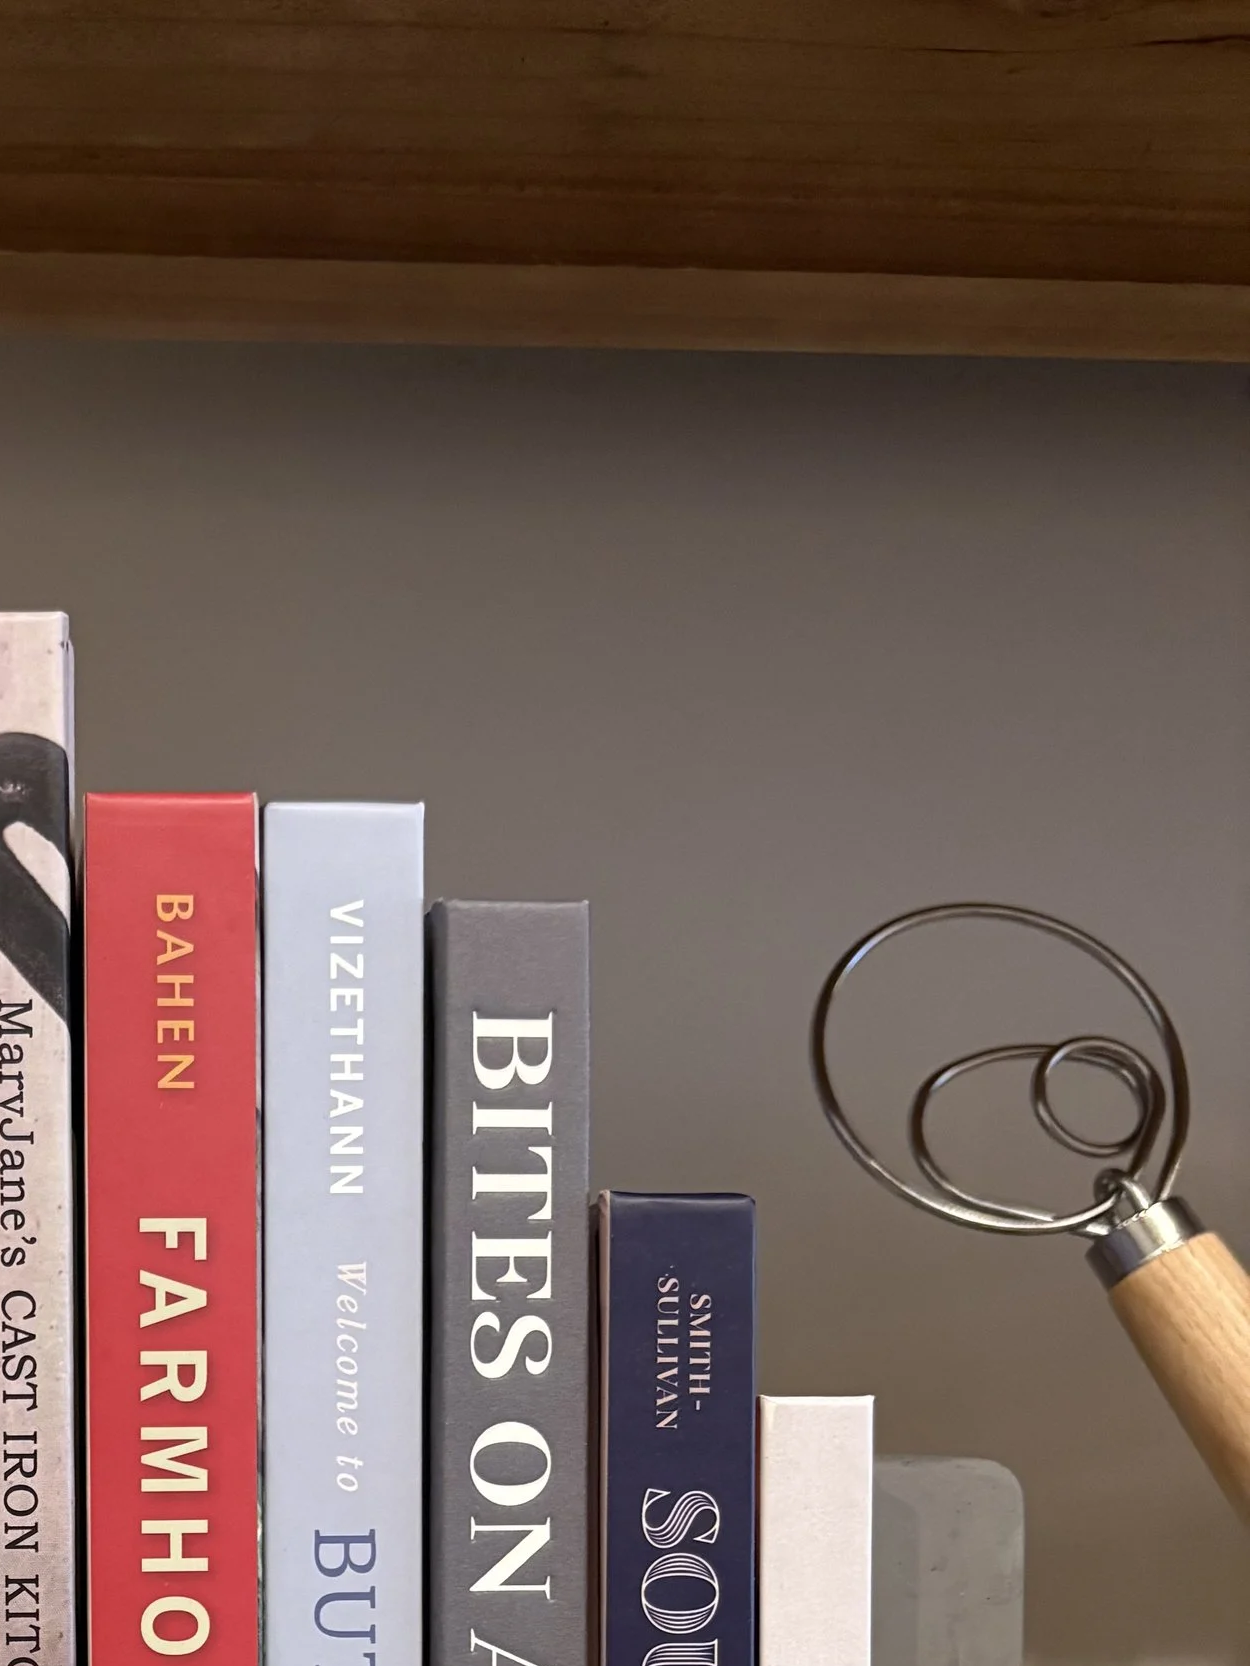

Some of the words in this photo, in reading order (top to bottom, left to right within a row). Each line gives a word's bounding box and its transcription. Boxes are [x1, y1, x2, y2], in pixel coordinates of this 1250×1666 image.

[155, 894, 195, 1090] BAHEN
[329, 899, 365, 1195] VIZETHANN
[470, 1011, 553, 1379] BITES
[0, 1289, 39, 1411] CAST
[335, 1260, 367, 1435] Welcome
[656, 1276, 680, 1430] SULLIVAN
[689, 1294, 712, 1410] SMITH-
[3, 1430, 39, 1553] IRON
[335, 1455, 364, 1492] to
[470, 1421, 551, 1599] ON
